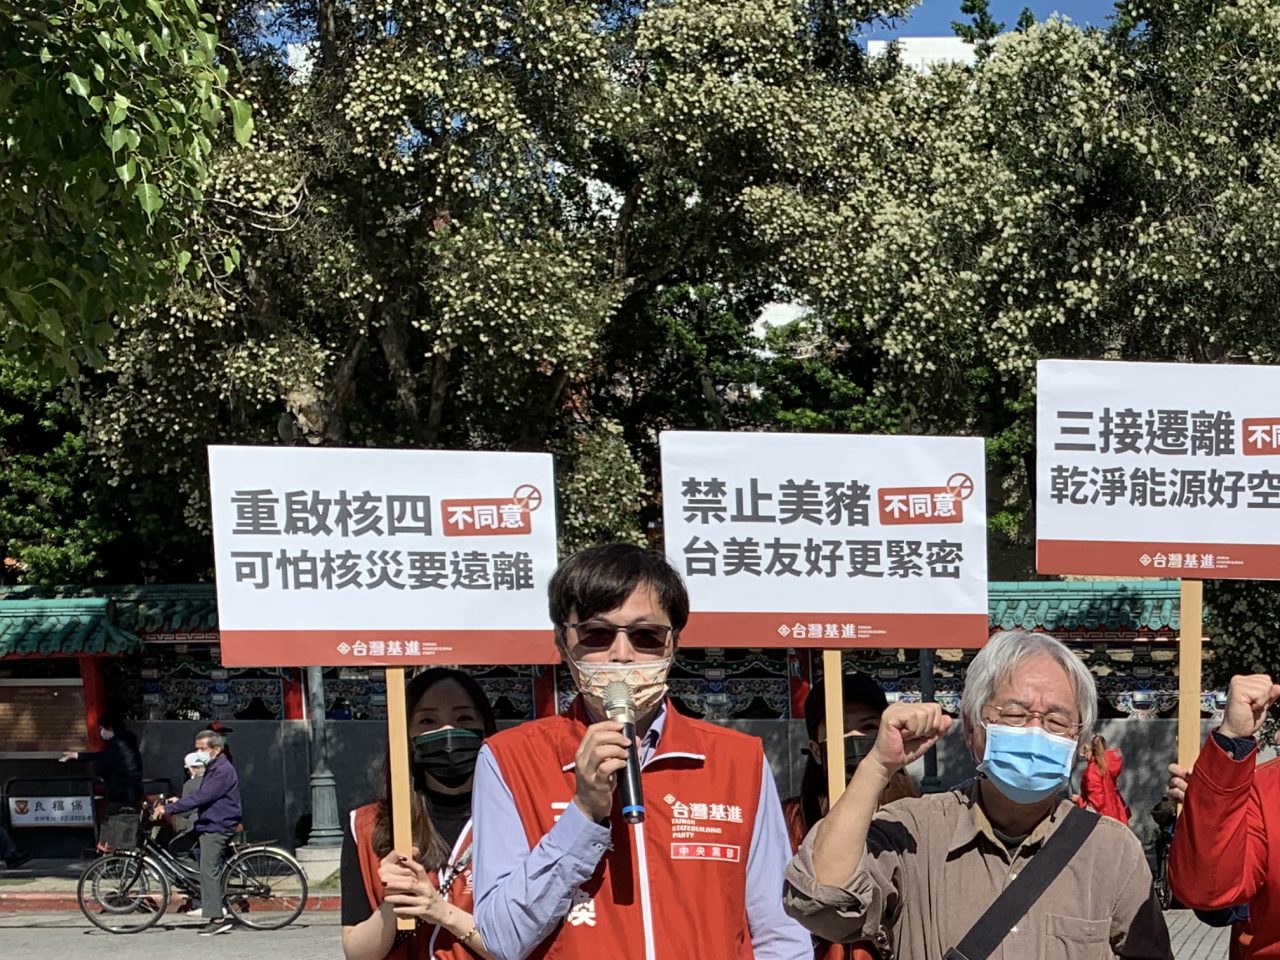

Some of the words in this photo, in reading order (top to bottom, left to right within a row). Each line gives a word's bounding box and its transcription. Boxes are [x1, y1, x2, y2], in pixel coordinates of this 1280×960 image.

[1054, 407, 1235, 457] 三接遷離
[231, 489, 432, 537] 重啟核四
[446, 503, 525, 530] 不同意
[681, 477, 871, 527] 禁止美豬
[883, 492, 957, 519] 不同意
[231, 549, 535, 591] 可怕核災要遠離
[682, 536, 963, 579] 台美友好更緊密
[1152, 552, 1215, 569] 台灣基進
[351, 640, 422, 656] 台灣基進
[791, 622, 857, 638] 台灣基進
[671, 801, 743, 823] 台灣基進
